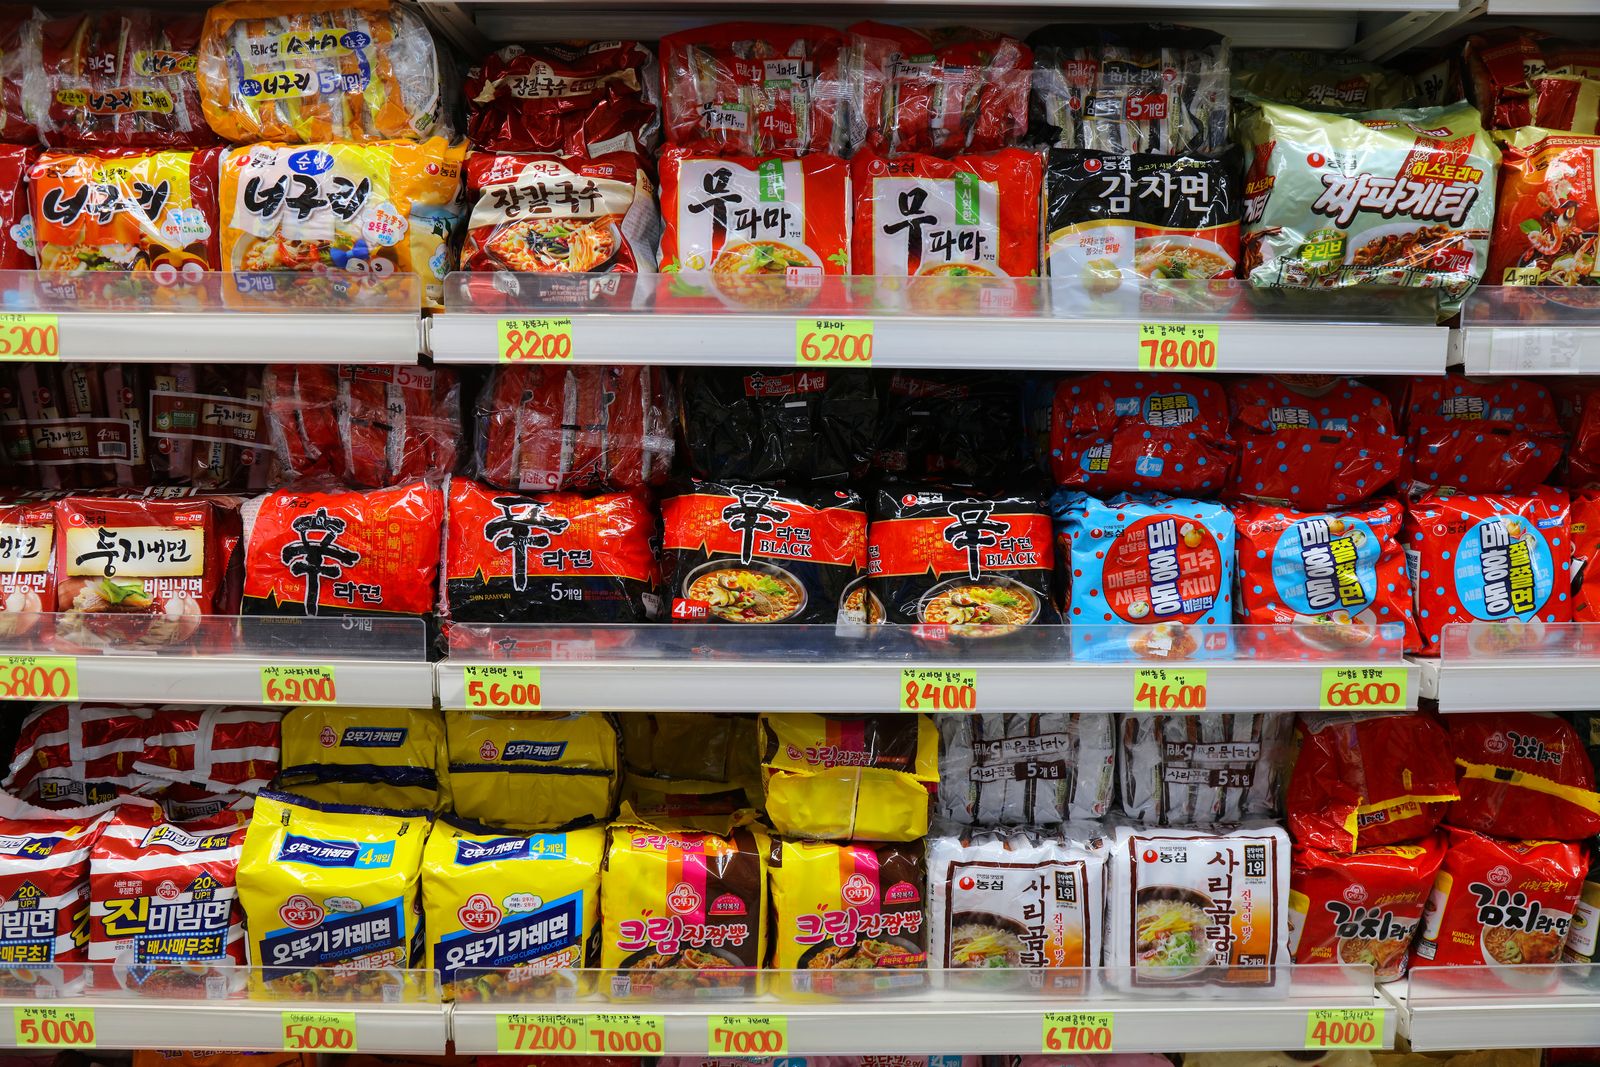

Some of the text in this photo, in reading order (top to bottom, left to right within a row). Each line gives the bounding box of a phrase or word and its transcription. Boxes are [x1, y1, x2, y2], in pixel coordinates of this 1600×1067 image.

[242, 74, 310, 95] 순한 너구리
[512, 78, 568, 99] 장칼국수
[1129, 97, 1165, 118] 5개입
[763, 116, 793, 135] 4개입
[440, 167, 458, 178] 농심
[1411, 160, 1482, 182] 히스토리팩
[244, 175, 370, 220] 너구리
[491, 180, 603, 218] 장칼국수
[1098, 171, 1213, 214] 감자면
[1314, 174, 1479, 227] 짜파게티
[43, 181, 169, 226] 너구리
[688, 168, 742, 267] 무
[734, 208, 792, 239] 파마
[883, 187, 986, 284] 무 파마
[1105, 244, 1121, 257] 면발
[1301, 241, 1342, 262] 올리브
[1433, 248, 1468, 272] 5개입
[236, 275, 274, 293] 5개입
[1503, 268, 1539, 286] 4개입
[43, 281, 77, 300] 5개입
[980, 288, 1014, 306] 4개입
[816, 320, 845, 331] 무파마
[1159, 324, 1186, 335] 감자면
[1192, 329, 1205, 338] 5입
[505, 330, 571, 360] 8200
[800, 332, 873, 362] 6200
[1140, 338, 1216, 369] 7800
[398, 365, 433, 389] 5개입
[205, 402, 254, 428] 둥지냉면
[37, 426, 86, 449] 둥지냉면
[98, 428, 120, 441] 4개입
[1138, 458, 1163, 476] 4개입
[523, 472, 558, 491] 5개입
[189, 512, 204, 521] 건면
[722, 484, 791, 565] 辛
[775, 528, 812, 546] 라면
[943, 502, 1034, 581] 辛 라면
[1103, 532, 1127, 542] 농심
[1127, 532, 1145, 544] 시원
[75, 527, 192, 579] 둥지냉면
[281, 506, 384, 618] 辛 라면
[541, 547, 594, 572] 라면
[759, 541, 812, 563] BLACK
[985, 553, 1038, 567] BLACK
[1179, 549, 1216, 575] 고추
[1147, 519, 1182, 616] 배홍동
[1298, 519, 1337, 610] 배홍동
[1329, 536, 1367, 608] 쫄쫄면
[1481, 521, 1514, 617] 배홍동
[1107, 569, 1148, 589] 매콤한
[1180, 574, 1216, 599] 치미
[1507, 540, 1540, 616] 쫄쫄면
[143, 578, 204, 600] 비빔냉면
[469, 592, 511, 602] SHIN RAMYUN
[550, 582, 583, 602] 5개입
[1115, 587, 1150, 606] 새콤
[673, 601, 707, 618] 4개입
[1181, 596, 1213, 614] 비빔면
[340, 613, 373, 633] 5개입
[914, 623, 947, 639] 4개입
[481, 667, 507, 679] 신라면
[266, 678, 337, 704] 6200
[468, 681, 541, 706] 5600
[905, 681, 977, 711] 8400
[1135, 682, 1207, 711] 4600
[1327, 682, 1401, 706] 6600
[344, 730, 403, 743] 오뚜기 카레면
[505, 743, 562, 757] 오뚜기 카레면
[1507, 731, 1562, 765] 김치라면
[1026, 760, 1059, 778] 5개입
[1218, 772, 1250, 786] 5개입
[24, 842, 52, 857] 4개입
[200, 835, 228, 850] 4개입
[461, 838, 564, 858] 오뚜기 카레면 4개입
[286, 843, 392, 867] 오뚜기 카레면 4개입
[1159, 852, 1188, 864] 농심
[1246, 862, 1265, 877] 1위
[18, 886, 42, 899] 20%
[159, 890, 179, 899] 오뚜기
[194, 876, 217, 892] 20%
[847, 888, 873, 900] 오뚜기
[976, 880, 1004, 891] 농심
[1057, 887, 1075, 901] 1위
[20, 899, 33, 909] UP
[194, 893, 206, 904] UP
[673, 897, 698, 908] 오뚜기
[716, 902, 741, 911] 복작복작
[1241, 889, 1252, 924] 진국의
[101, 896, 232, 938] 진비빔면
[288, 911, 318, 924] 오뚜기
[465, 912, 495, 924] 오뚜기
[1469, 883, 1571, 938] 김치라면
[616, 916, 749, 956] 크림 진짬뽕
[794, 907, 922, 948] 크림 진짬뽕
[1053, 913, 1064, 946] 진국의
[147, 940, 220, 956] 배사매무초!
[272, 917, 392, 967] 오뚜기 카레면
[444, 912, 570, 971] 오뚜기 카레면
[1451, 930, 1475, 947] KIMCHI RAMEN
[319, 940, 392, 960] OTTOGI CURRY NOODLE
[519, 947, 541, 959] CURRY
[20, 1019, 94, 1044] 5000
[285, 1023, 353, 1049] 5000
[508, 1023, 576, 1050] 7200
